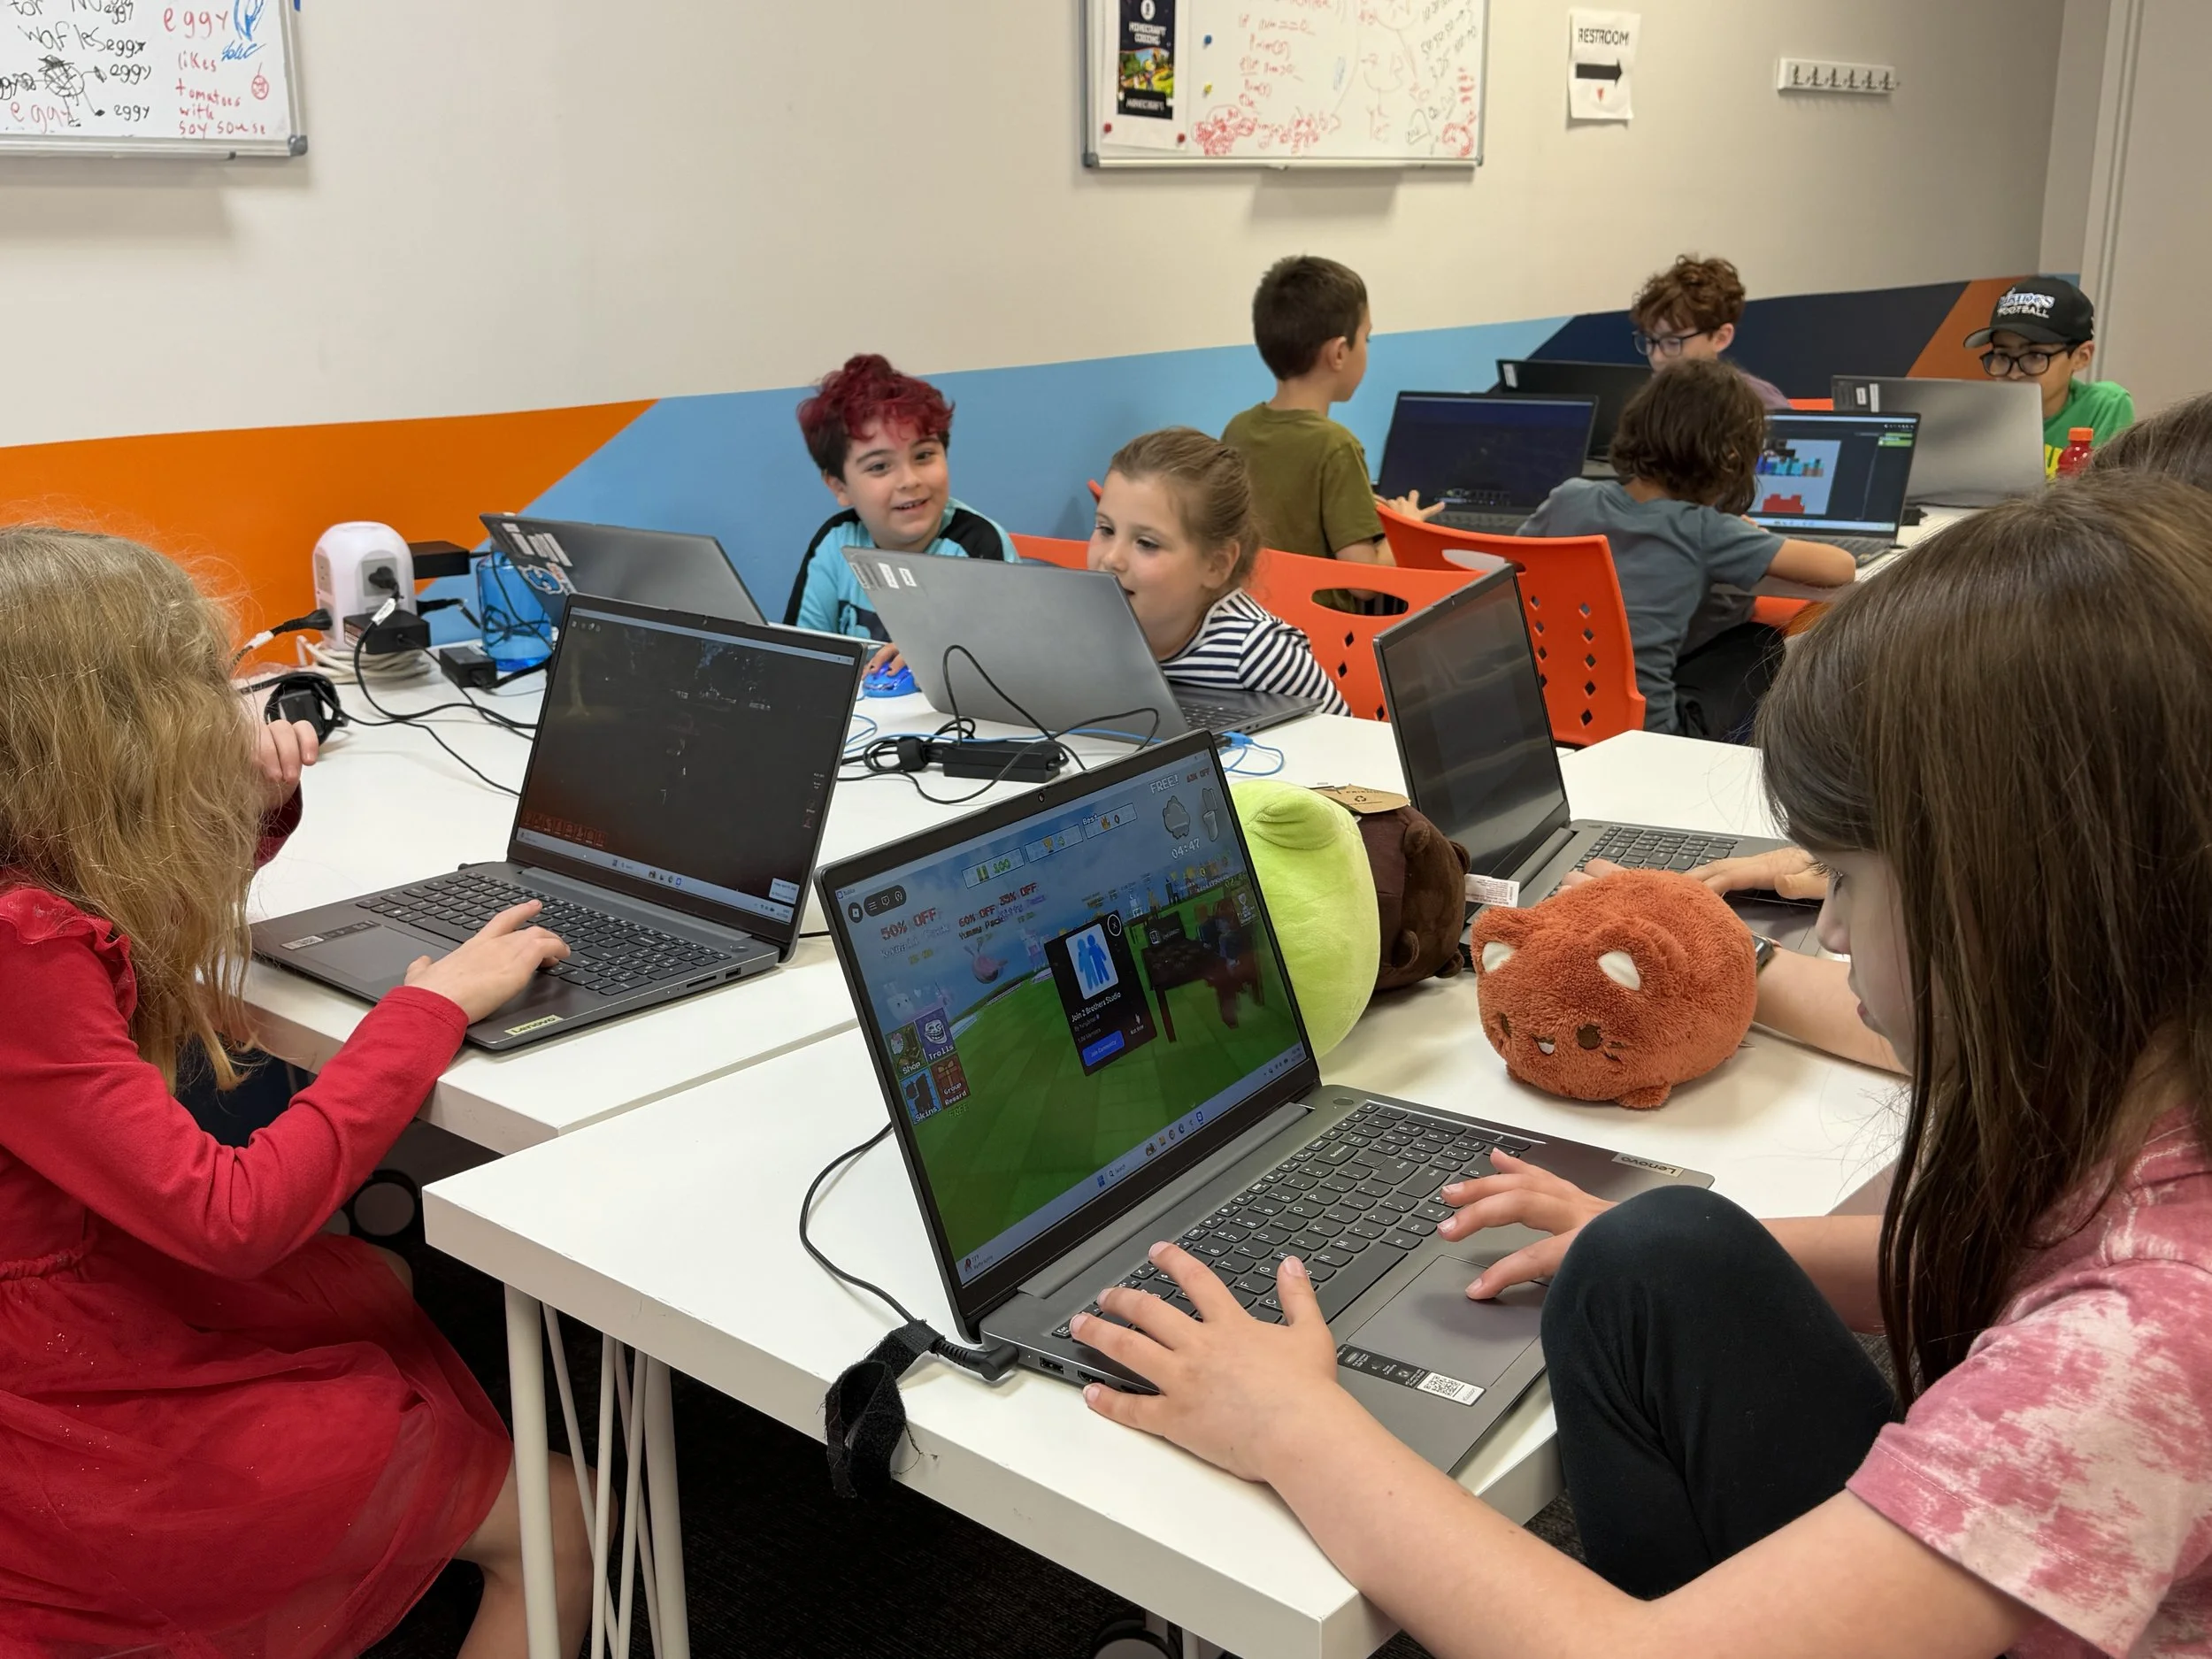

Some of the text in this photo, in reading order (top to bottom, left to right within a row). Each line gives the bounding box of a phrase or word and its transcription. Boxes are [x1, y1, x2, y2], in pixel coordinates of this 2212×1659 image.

[163, 7, 228, 40] eggy
[1578, 28, 1630, 46] RESTROOM
[178, 50, 218, 73] likes
[110, 64, 151, 85] eggy
[180, 103, 214, 120] with
[1125, 97, 1165, 111] MINECRAFT
[113, 104, 150, 122] eggy
[179, 120, 209, 139] soy
[1997, 304, 2050, 319] FOOTBALL
[1149, 775, 1179, 794] FREE!
[1171, 838, 1201, 859] 04:47
[1019, 882, 1037, 897] OFF
[979, 905, 996, 918] OFF
[880, 907, 938, 941] 50% OFF
[1071, 1011, 1082, 1023] Join
[1085, 1000, 1106, 1015] Brothers
[1105, 991, 1121, 1005] Studio
[511, 1018, 556, 1033] Lenovo
[928, 1045, 955, 1061] Trolls
[902, 1061, 921, 1074] Shop
[943, 1082, 962, 1095] Group
[944, 1090, 967, 1105] Reward
[915, 1106, 939, 1122] Skins
[1620, 1156, 1677, 1174] Lenovo
